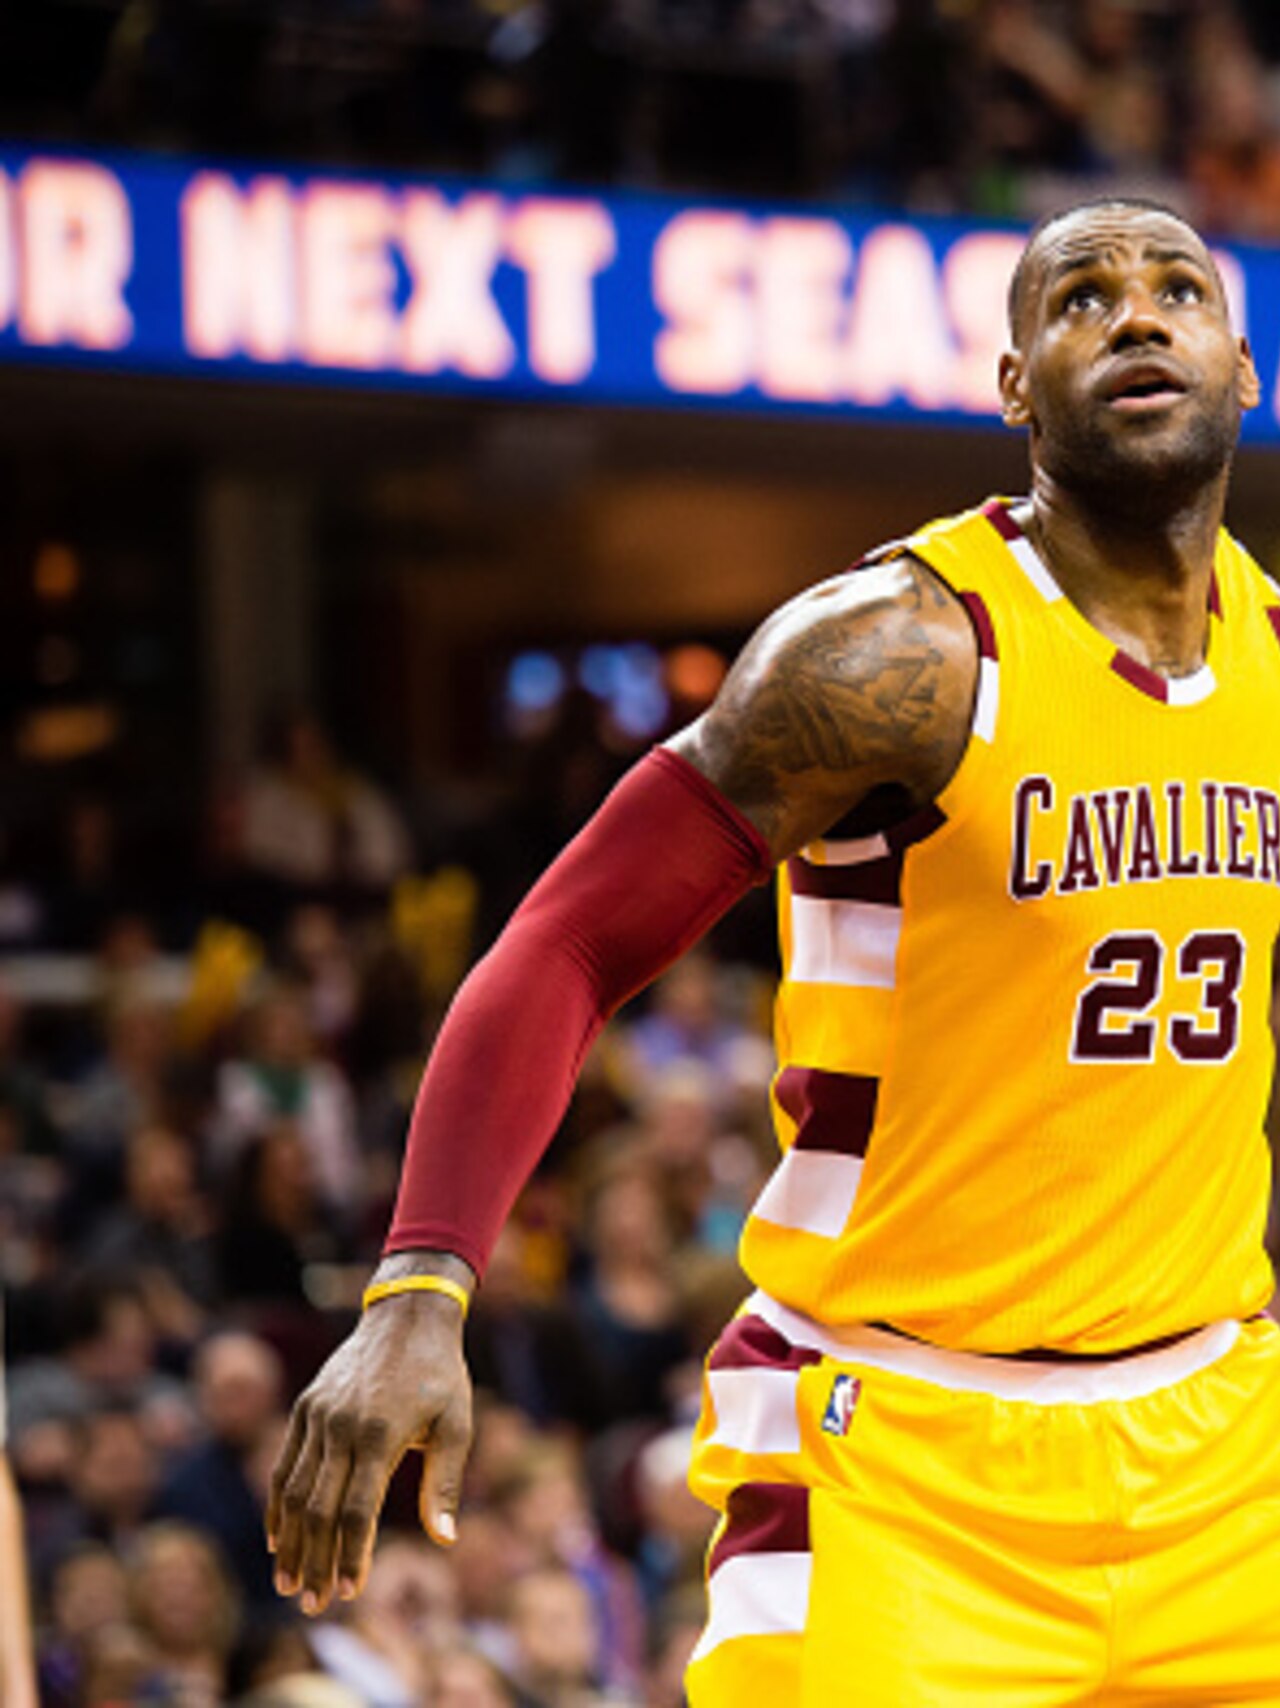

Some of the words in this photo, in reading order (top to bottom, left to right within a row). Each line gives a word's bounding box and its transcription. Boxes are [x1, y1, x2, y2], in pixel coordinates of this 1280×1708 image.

[0, 155, 133, 350] R
[180, 168, 618, 386] NEXT
[652, 208, 1246, 415] SEAS
[1068, 930, 1246, 1065] 23
